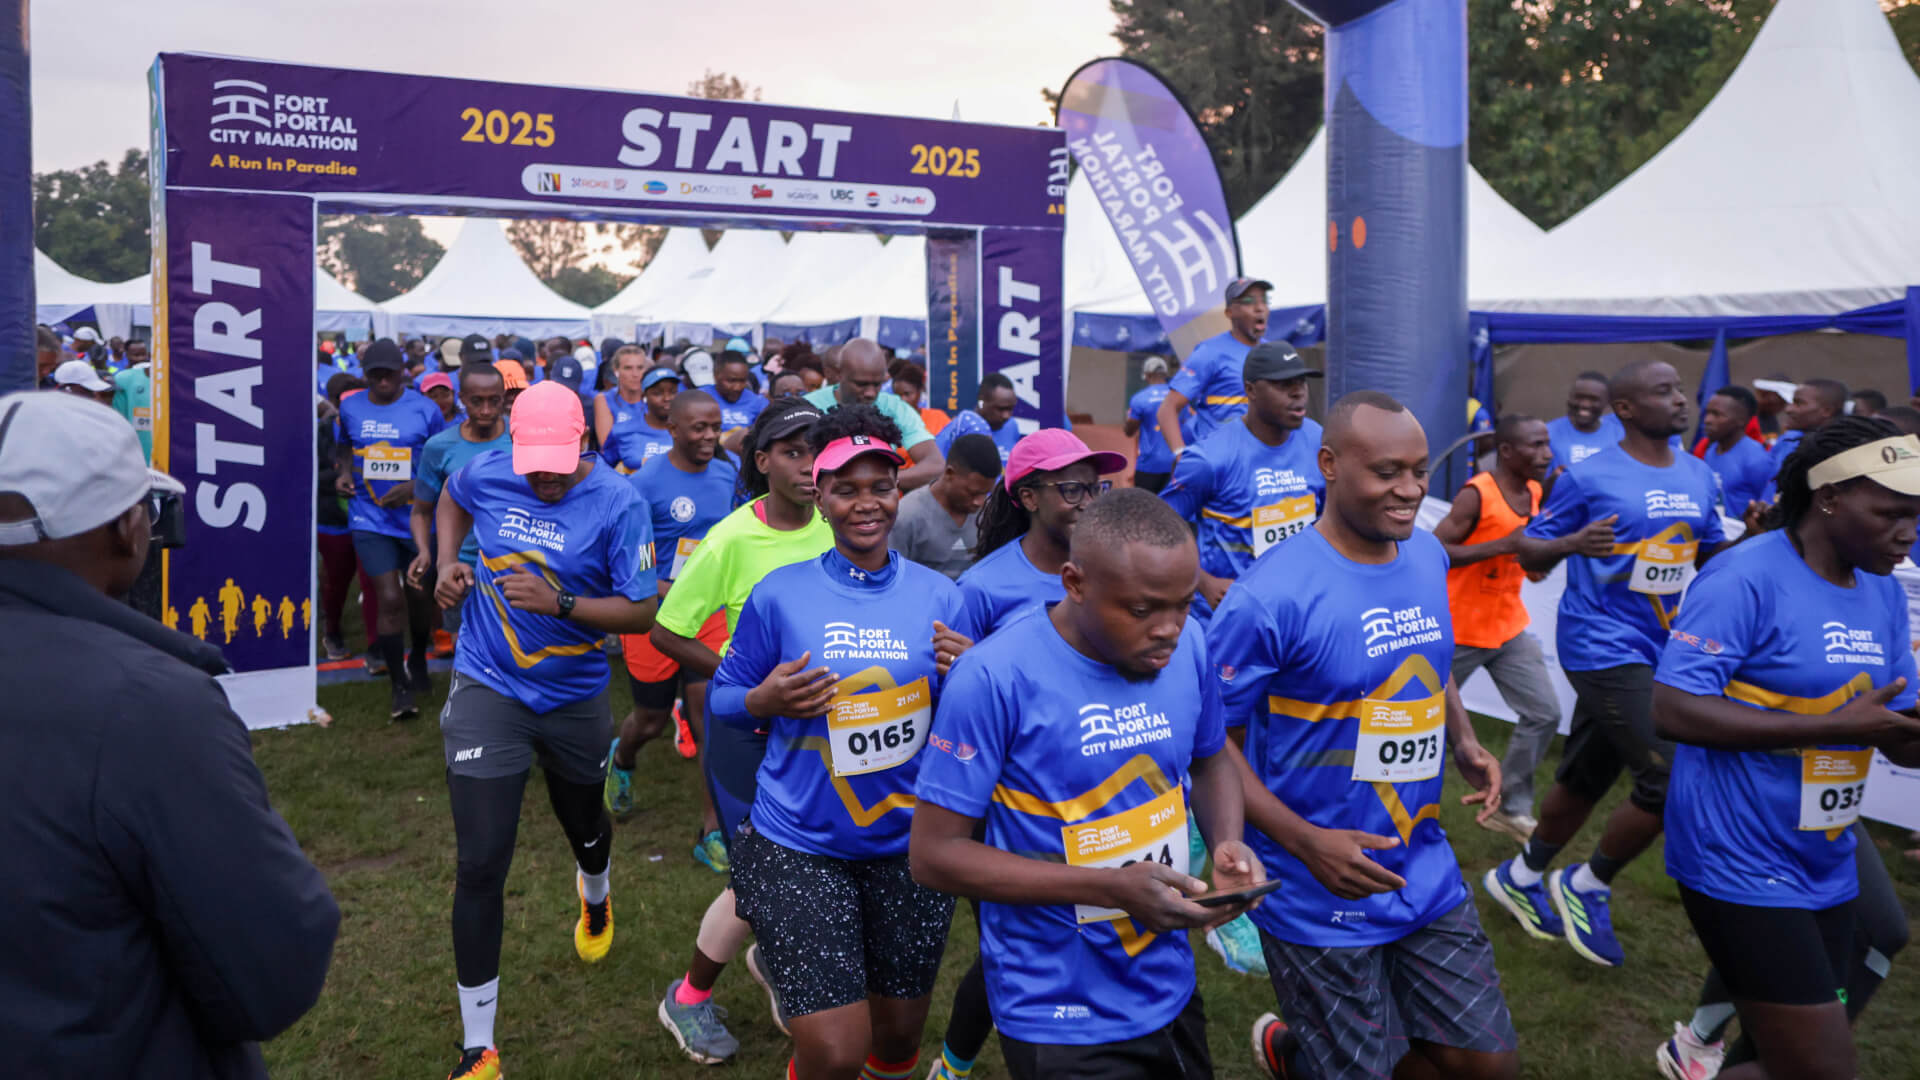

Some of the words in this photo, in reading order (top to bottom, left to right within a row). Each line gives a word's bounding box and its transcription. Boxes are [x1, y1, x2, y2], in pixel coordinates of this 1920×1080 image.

[274, 94, 328, 114] FORT
[275, 112, 357, 134] PORTAL
[460, 107, 556, 148] 2025
[210, 128, 249, 144] CITY
[255, 131, 357, 151] MARATHON
[617, 107, 853, 178] START
[210, 154, 224, 168] A
[229, 156, 262, 170] Run
[266, 158, 282, 172] In
[285, 159, 357, 176] Paradise
[911, 144, 981, 178] 2025
[830, 189, 854, 201] UBC
[998, 265, 1041, 436] ART
[191, 241, 267, 533] START
[371, 462, 400, 473] 0179
[531, 518, 557, 532] FORT
[498, 529, 517, 540] CITY
[518, 533, 564, 552] MARATHON
[529, 527, 565, 544] PORTAL
[1393, 606, 1421, 623] FORT
[859, 629, 891, 639] FORT
[1396, 616, 1440, 636] PORTAL
[1848, 629, 1872, 641] FORT
[859, 639, 907, 651] PORTAL
[1367, 643, 1388, 658] CITY
[1389, 630, 1442, 652] MARATHON
[1851, 641, 1884, 654] PORTAL
[823, 650, 845, 660] CITY
[849, 650, 908, 661] MARATHON
[1826, 654, 1844, 665] CITY
[907, 691, 920, 704] KM
[1114, 702, 1147, 722] FORT
[1117, 712, 1170, 735] PORTAL
[848, 719, 915, 756] 0165
[1081, 741, 1107, 756] CITY
[1109, 727, 1172, 751] MARATHON
[454, 747, 483, 762] NIKE
[1379, 734, 1437, 765] 0973
[1149, 812, 1161, 827] 21
[1161, 804, 1176, 821] KM
[1100, 825, 1119, 836] FORT
[1100, 830, 1131, 843] PORTAL
